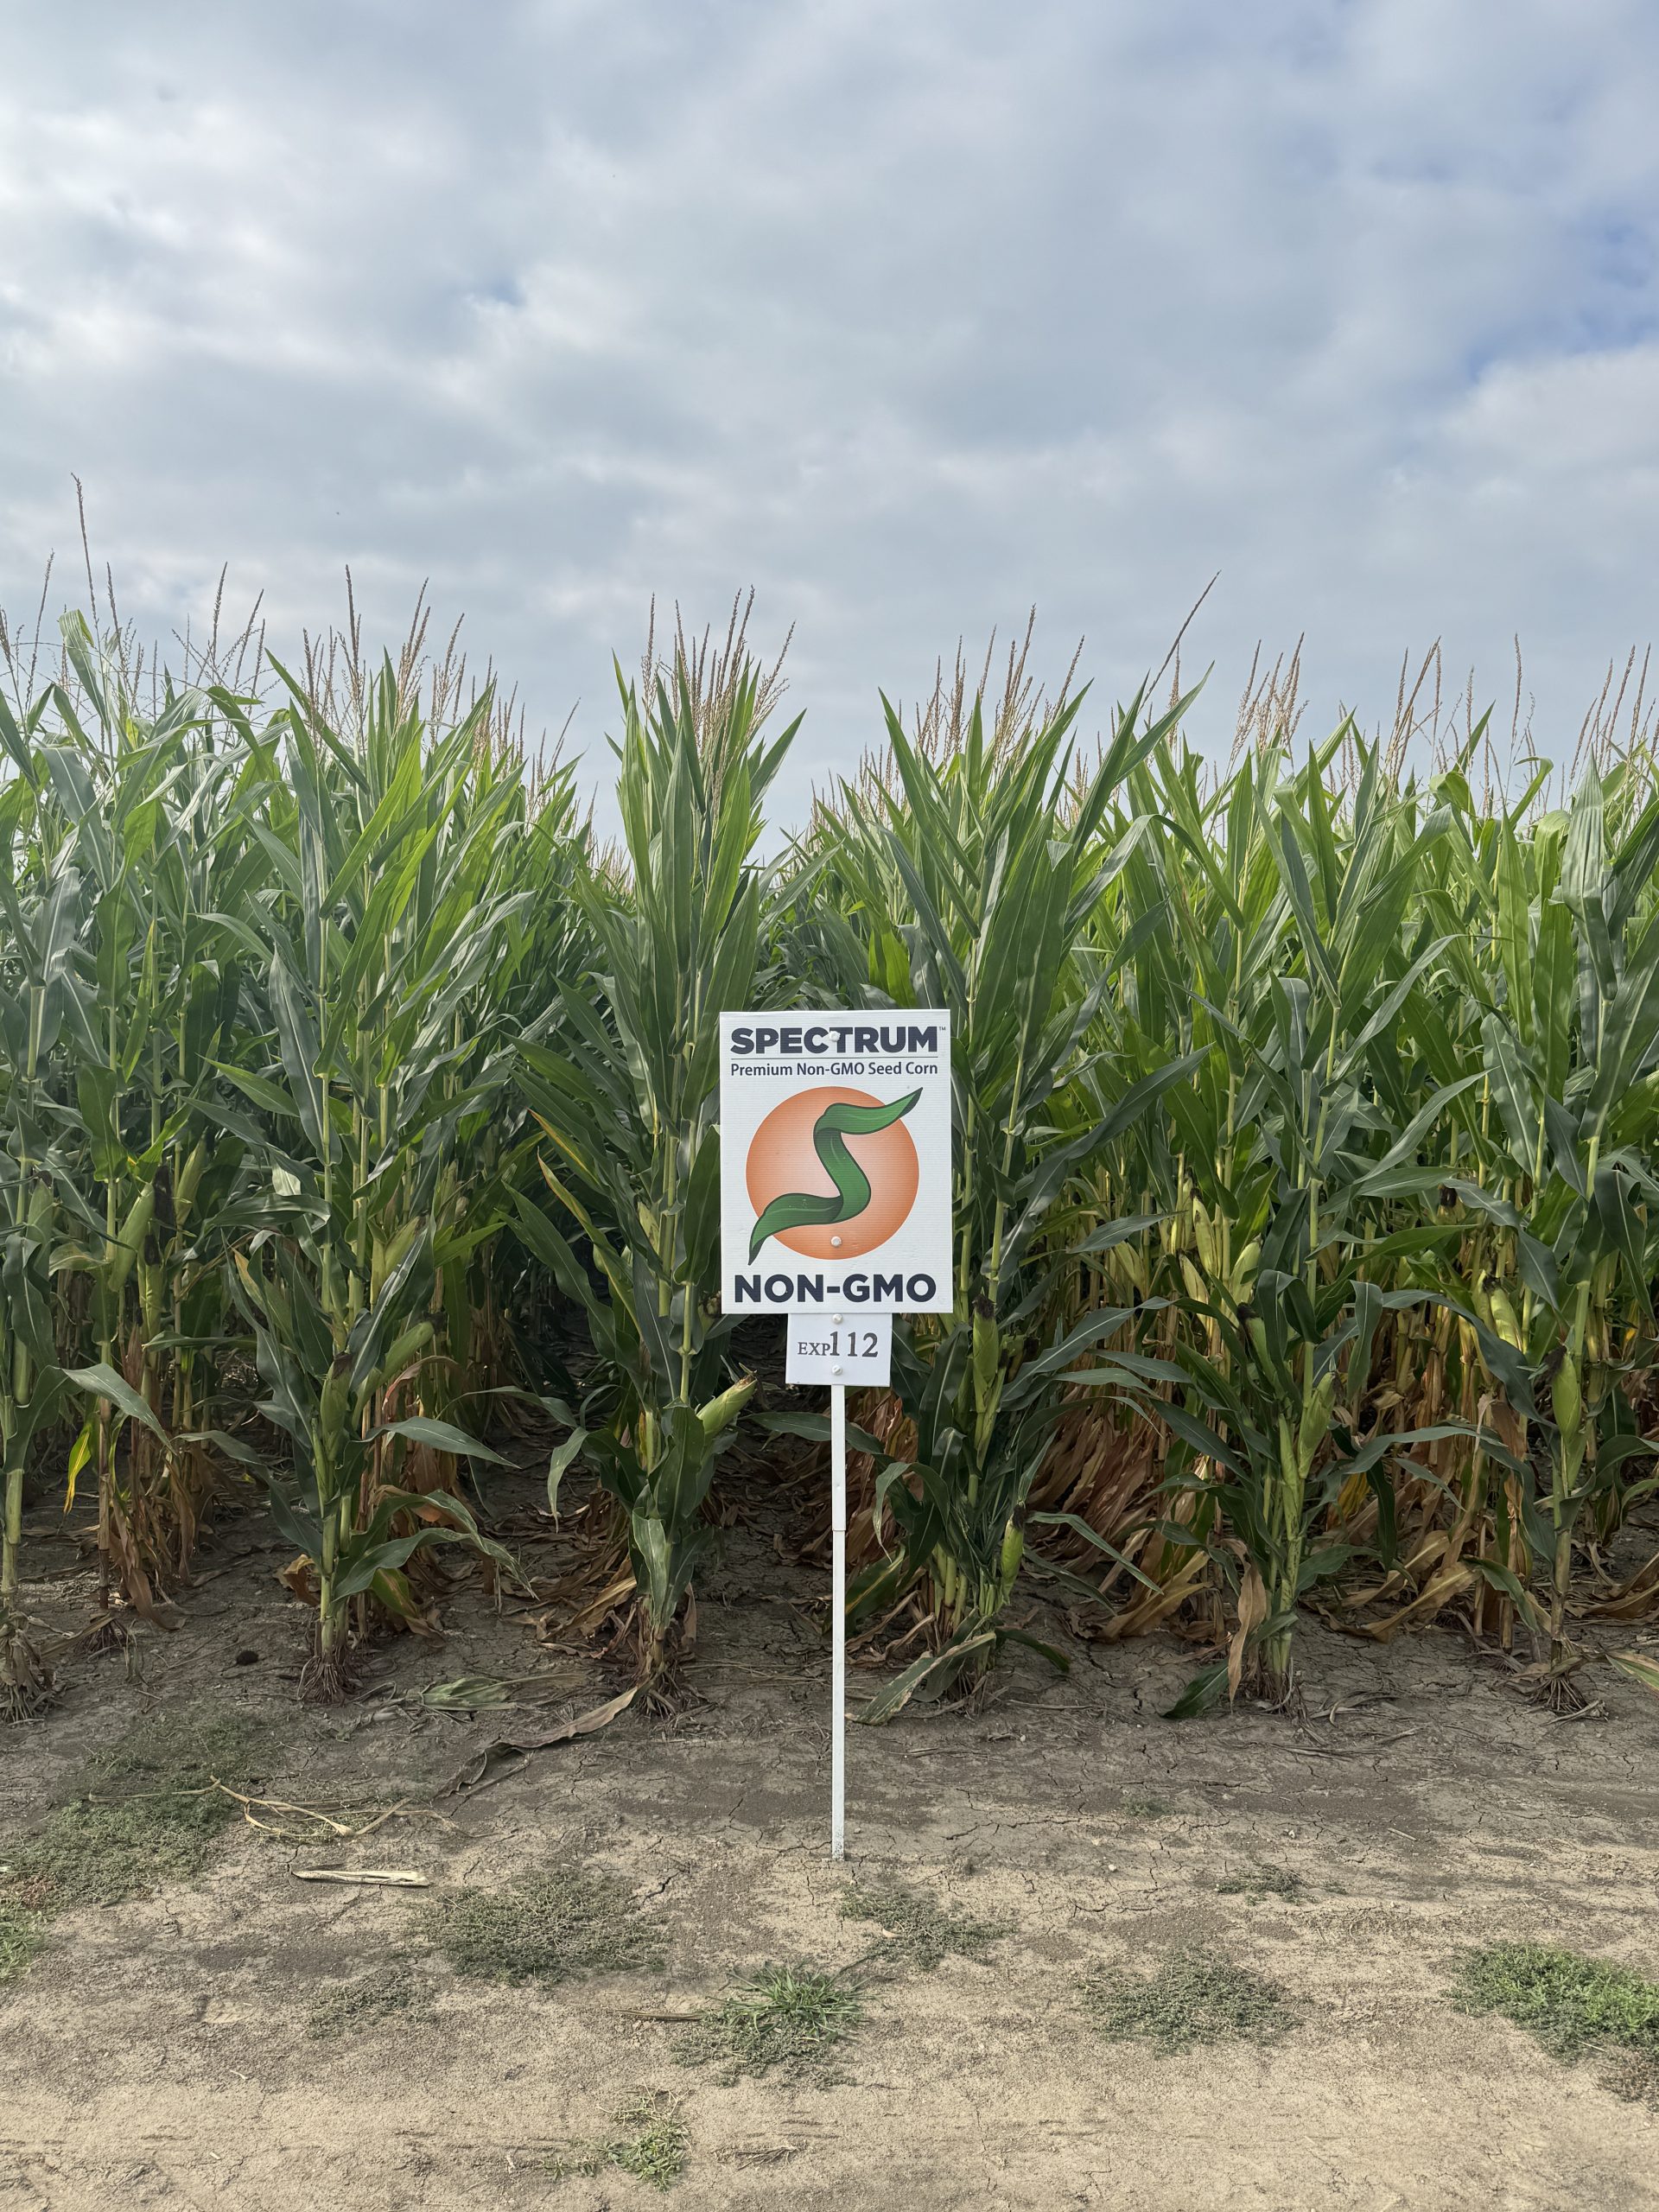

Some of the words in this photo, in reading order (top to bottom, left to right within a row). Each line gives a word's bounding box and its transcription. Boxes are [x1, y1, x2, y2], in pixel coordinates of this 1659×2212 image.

[730, 1026, 938, 1054] SPECTRUM
[731, 1064, 792, 1076] Premium
[797, 1063, 864, 1075] Non-GMO
[868, 1062, 901, 1074] Seed
[906, 1062, 938, 1074] Corn
[734, 1273, 937, 1303] NON-GMO
